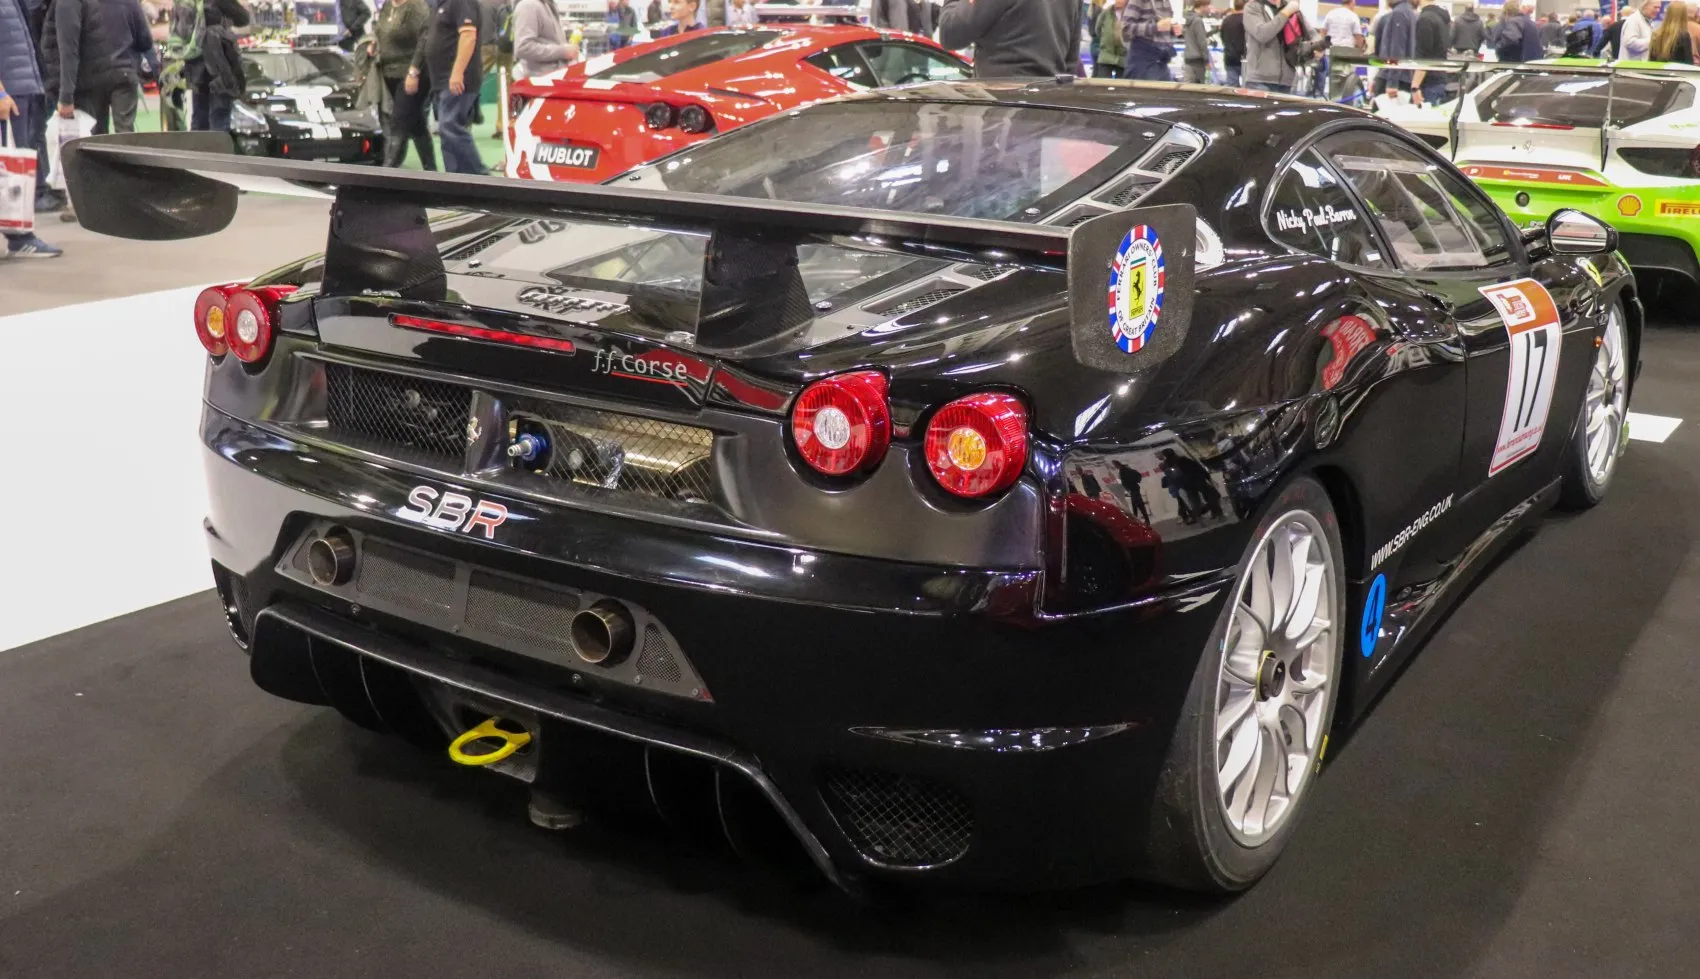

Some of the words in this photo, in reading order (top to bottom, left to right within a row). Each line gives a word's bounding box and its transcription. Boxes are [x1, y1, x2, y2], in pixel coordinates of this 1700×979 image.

[537, 145, 593, 167] HUBLOT
[1276, 208, 1307, 235] Nicky
[1116, 252, 1131, 301] FERRARI
[1122, 321, 1138, 336] GREAT
[1137, 297, 1156, 333] BRITAIN
[1513, 328, 1548, 433] 17
[396, 485, 508, 540] SBR
[1370, 492, 1454, 571] WWW.SBR-ENG.CO.UK
[1366, 584, 1381, 642] 4
